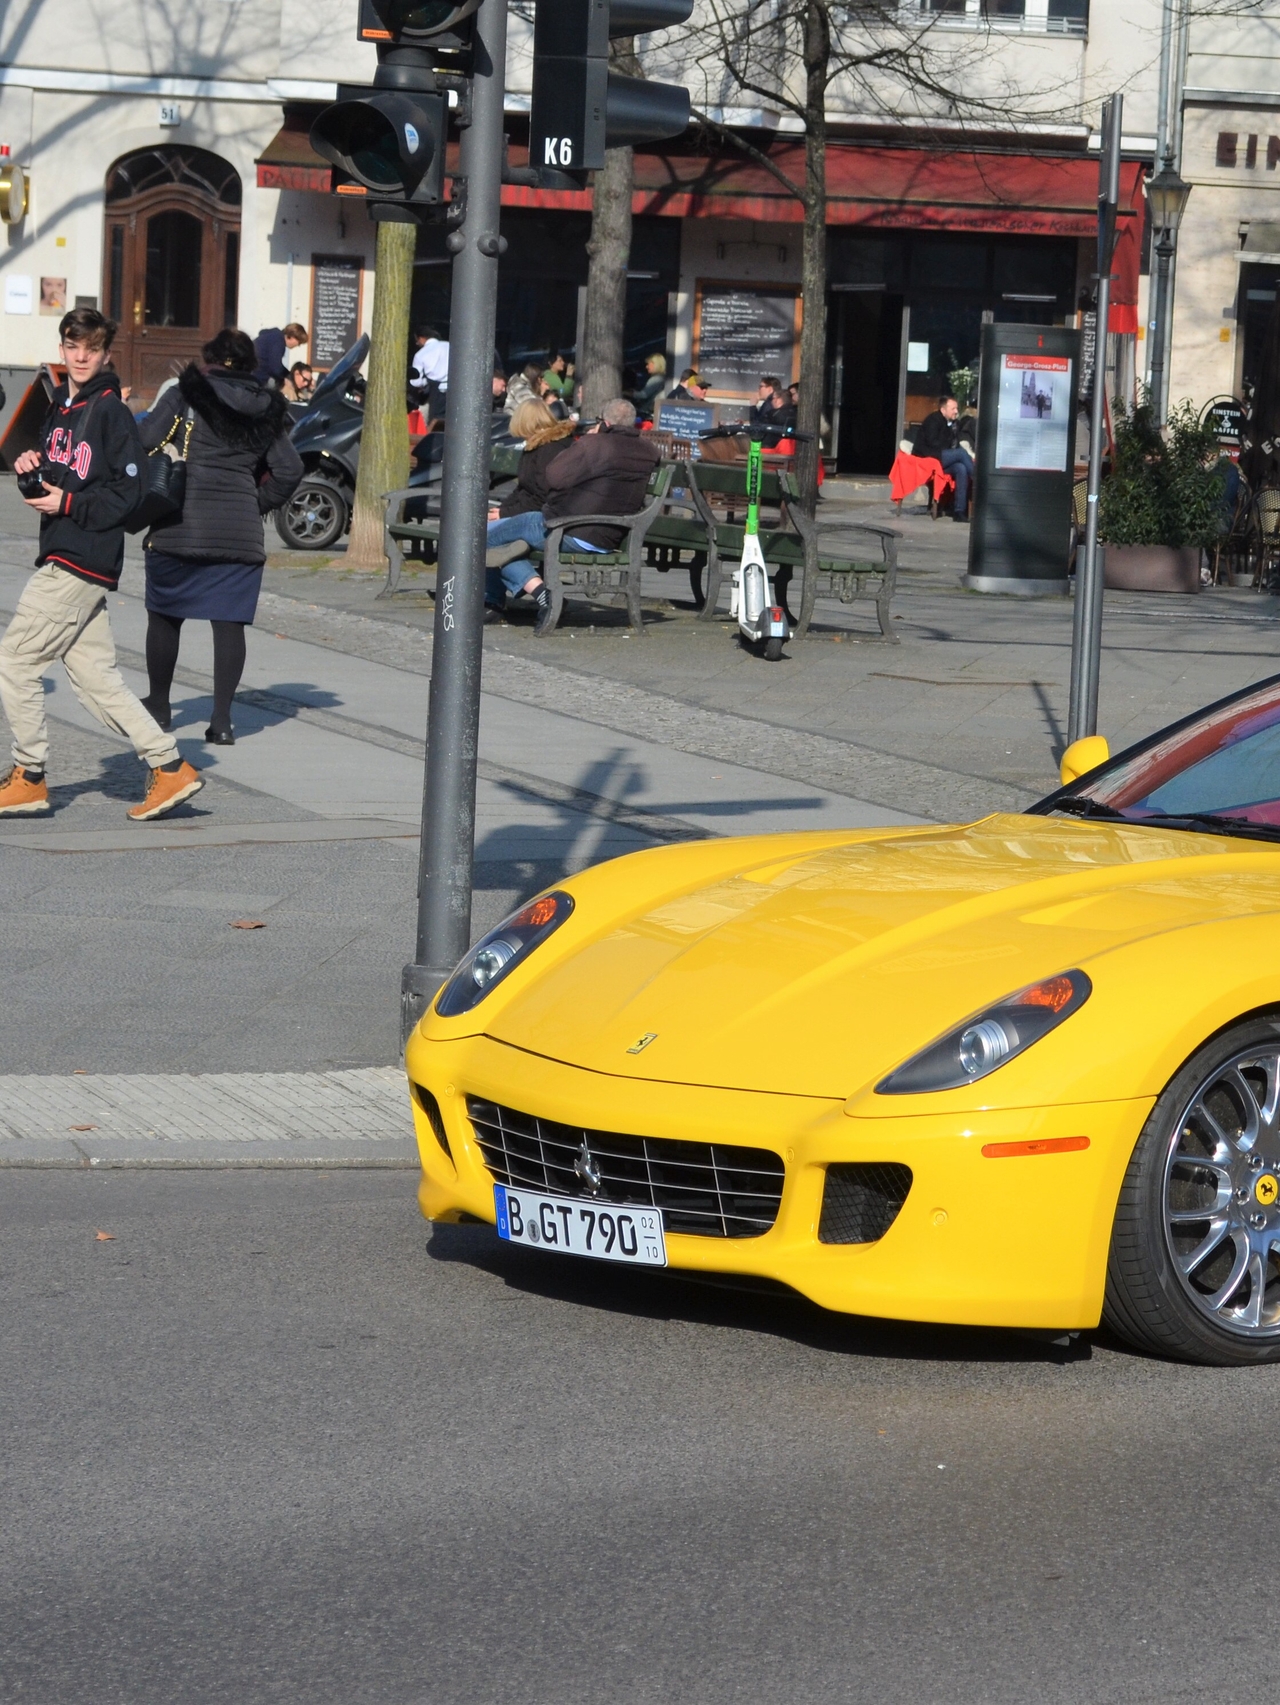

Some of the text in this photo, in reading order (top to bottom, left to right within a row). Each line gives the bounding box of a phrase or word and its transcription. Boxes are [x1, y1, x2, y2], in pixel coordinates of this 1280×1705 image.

[161, 108, 174, 120] 51
[544, 137, 572, 166] K6
[1007, 360, 1067, 371] George-Grosz-Platz
[1212, 408, 1240, 417] EINSTEIN
[1212, 426, 1239, 435] KAFFEE
[500, 1217, 506, 1230] D
[508, 1196, 638, 1256] B GT 790
[641, 1216, 655, 1230] 02
[646, 1245, 659, 1258] 10
